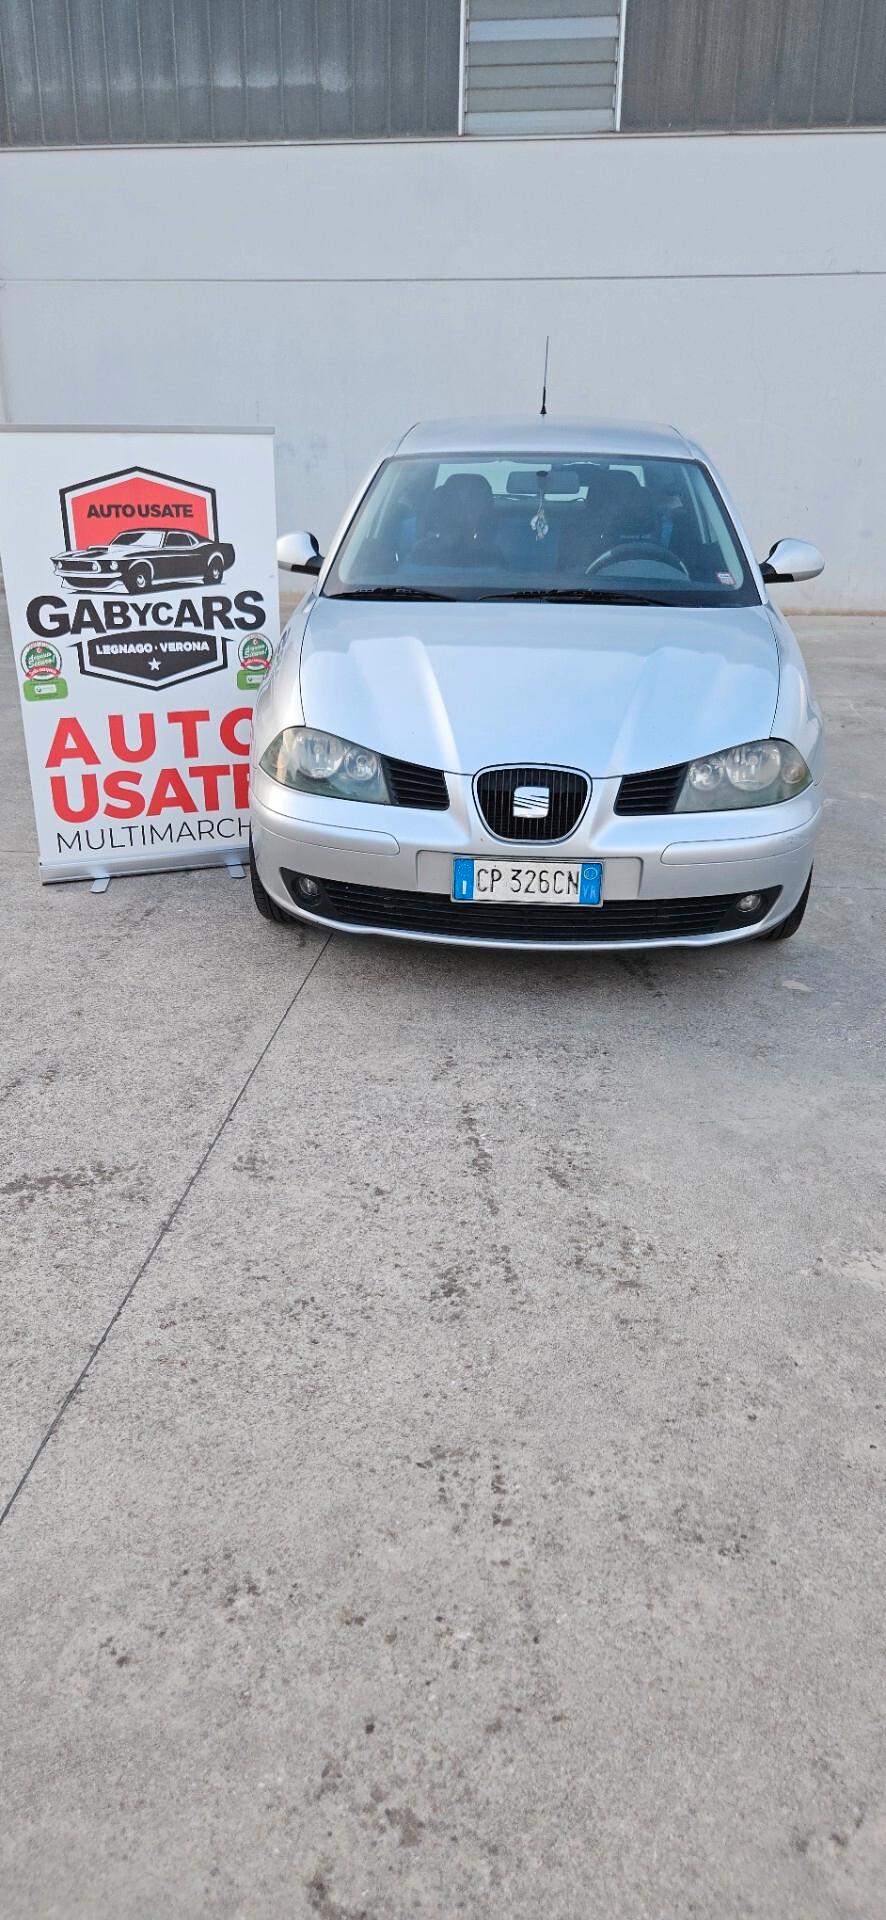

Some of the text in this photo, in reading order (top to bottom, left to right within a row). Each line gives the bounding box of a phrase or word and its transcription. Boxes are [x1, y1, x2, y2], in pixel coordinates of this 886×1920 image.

[87, 503, 193, 518] AUTO USATE
[25, 590, 266, 638] GABYCARS
[95, 640, 210, 655] LEGNAGO VERONA
[45, 707, 252, 768] AUTO
[477, 868, 580, 895] CP 326CN
